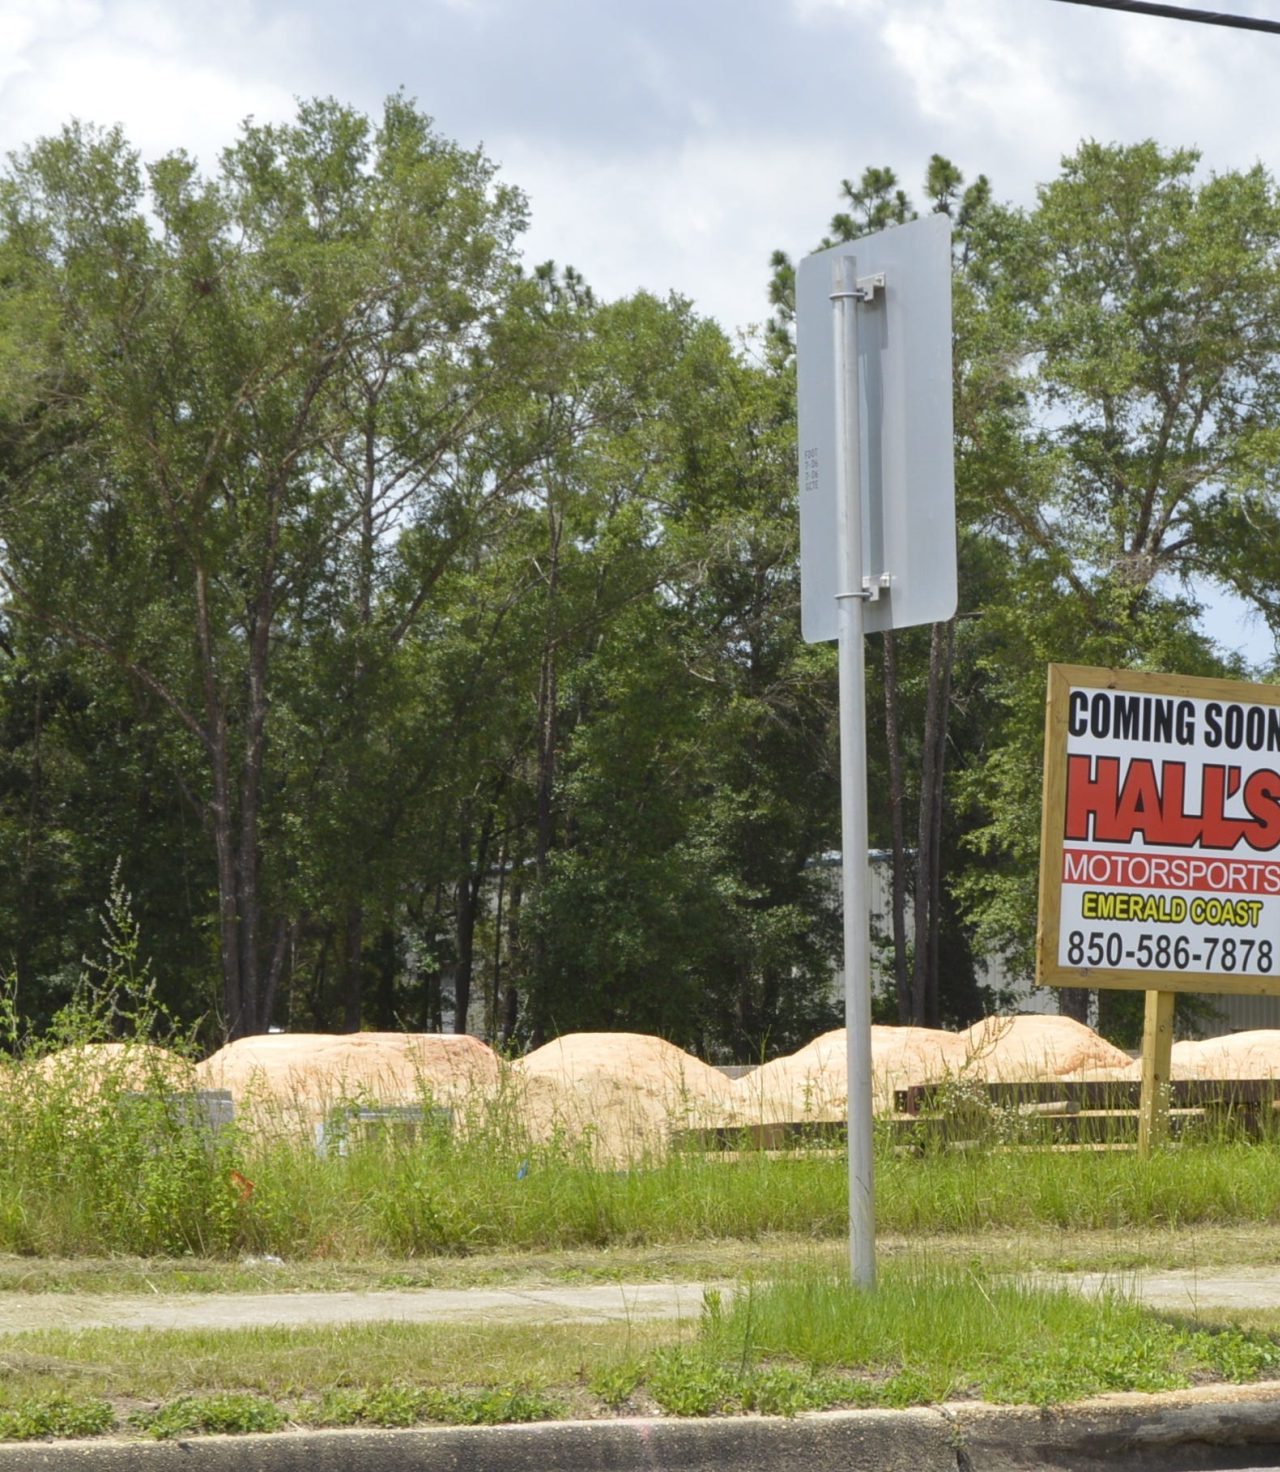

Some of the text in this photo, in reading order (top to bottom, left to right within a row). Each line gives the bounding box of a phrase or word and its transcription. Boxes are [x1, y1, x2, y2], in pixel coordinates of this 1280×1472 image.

[1068, 691, 1195, 745] COMING
[1082, 891, 1263, 928] EMERALD COAST
[1068, 931, 1273, 973] 850-586-7878
